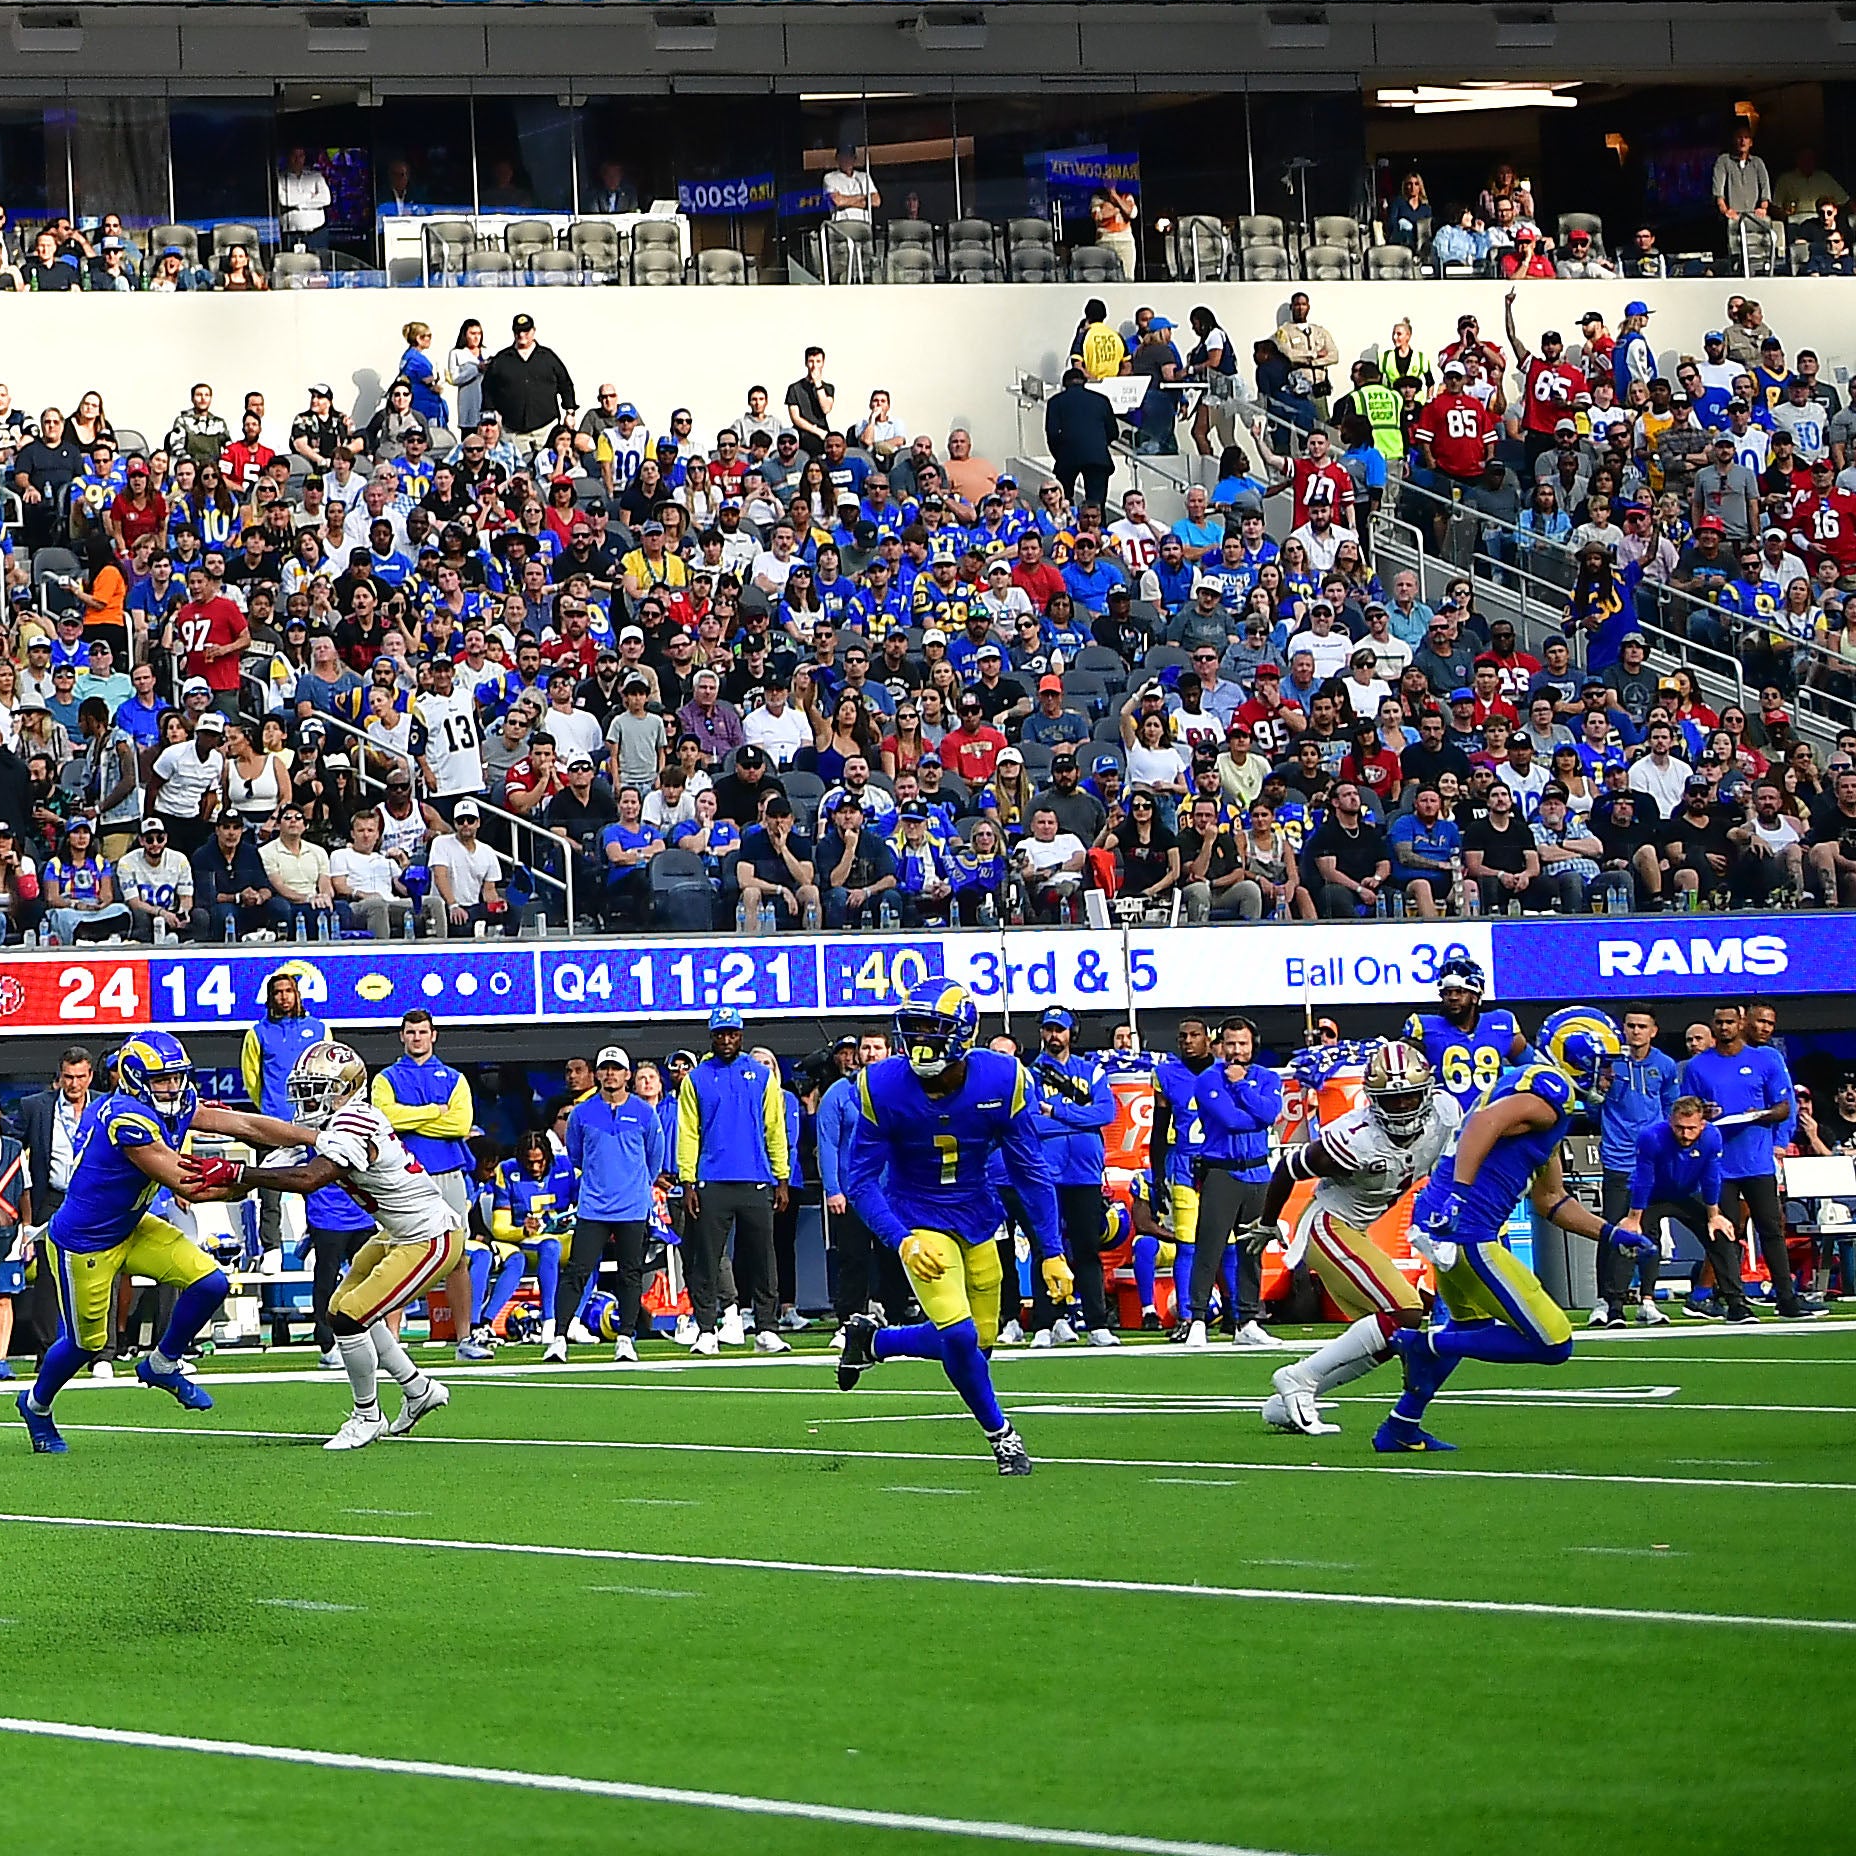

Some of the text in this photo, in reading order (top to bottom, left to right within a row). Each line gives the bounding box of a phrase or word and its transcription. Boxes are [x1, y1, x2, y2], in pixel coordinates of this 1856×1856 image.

[1535, 370, 1569, 401] 85
[1447, 410, 1477, 438] 85
[202, 518, 228, 543] 10
[1814, 508, 1839, 539] 16
[1126, 539, 1159, 569] 16
[182, 621, 210, 650] 97
[443, 716, 474, 752] 13
[970, 949, 1157, 995] 3rd & 5
[1286, 958, 1343, 986] Ball
[1354, 957, 1401, 985] On
[1599, 936, 1788, 976] RAMS
[59, 966, 235, 1018] 24 14
[554, 948, 928, 1005] Q4 11:21 :40
[1443, 1046, 1502, 1093] 68
[934, 1136, 957, 1183] 1
